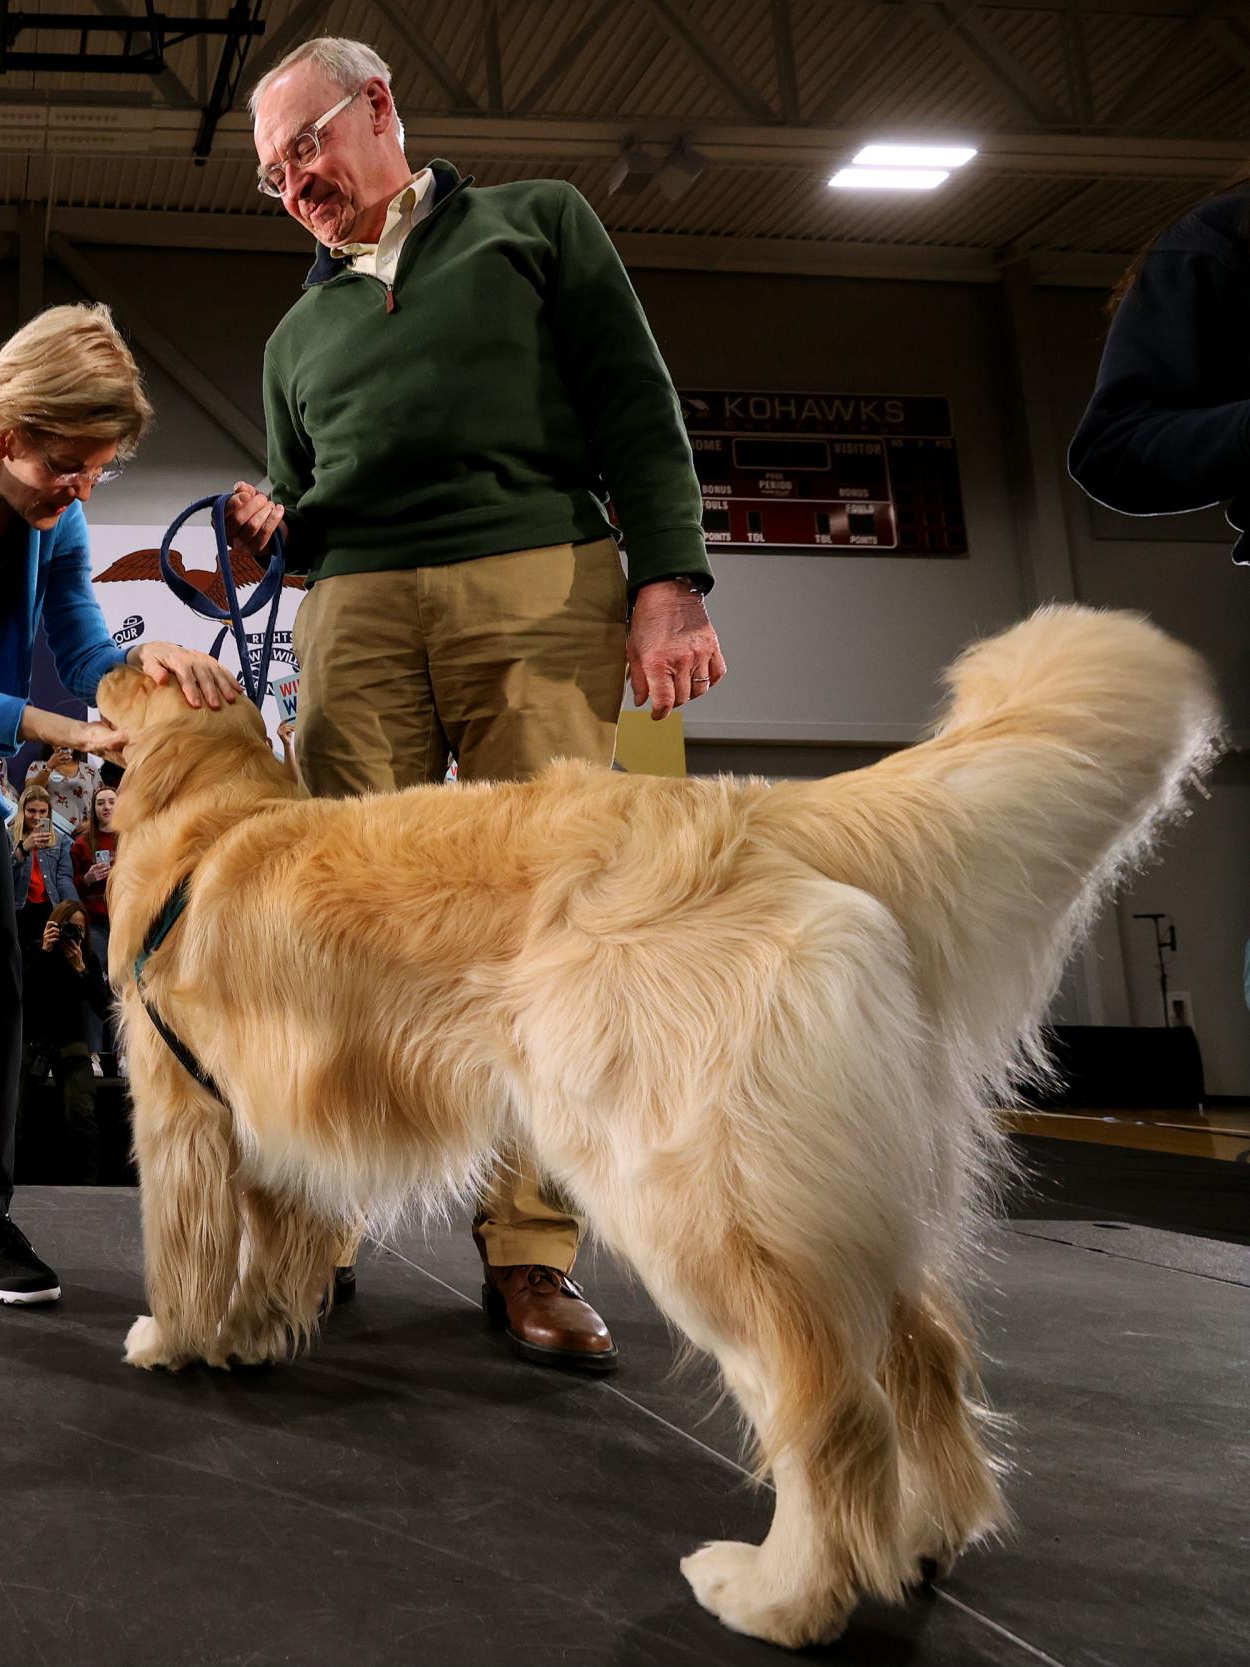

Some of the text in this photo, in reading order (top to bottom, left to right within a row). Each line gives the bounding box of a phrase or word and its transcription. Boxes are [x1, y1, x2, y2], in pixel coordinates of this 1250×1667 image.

[724, 396, 906, 423] KOHAWKS
[833, 442, 882, 456] VISITOR
[701, 484, 732, 495] BONUS
[758, 480, 792, 490] PERIOD
[838, 488, 869, 498] BONUS
[845, 504, 874, 514] FOULS
[850, 535, 878, 545] POINTS
[115, 628, 138, 643] OUR
[252, 632, 294, 643] RIHTS
[280, 679, 300, 698] WI
